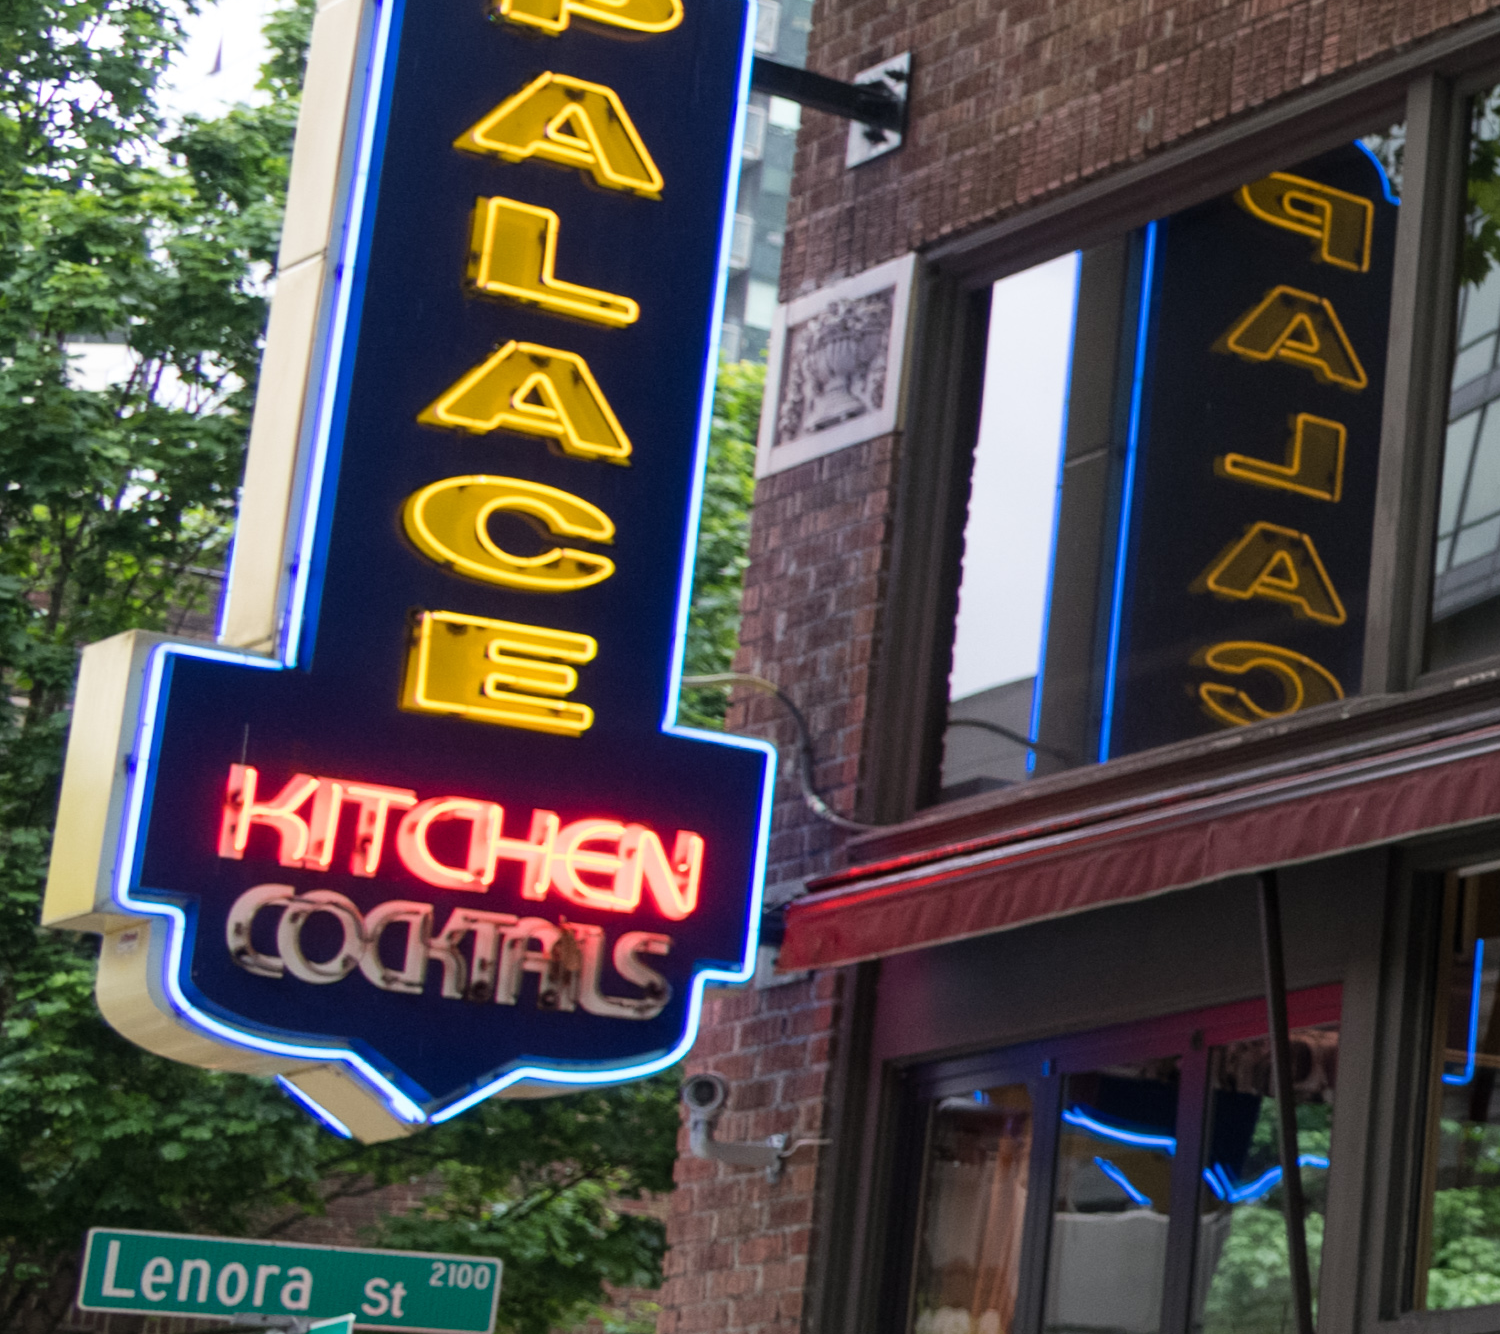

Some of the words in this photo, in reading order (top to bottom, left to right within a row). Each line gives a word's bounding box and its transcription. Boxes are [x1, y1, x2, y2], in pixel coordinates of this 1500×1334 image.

[218, 763, 704, 921] KITCHEN
[226, 882, 672, 1020] COCKTAILS
[102, 1240, 313, 1310] Lenora
[361, 1277, 408, 1318] St
[429, 1262, 491, 1291] 2100
